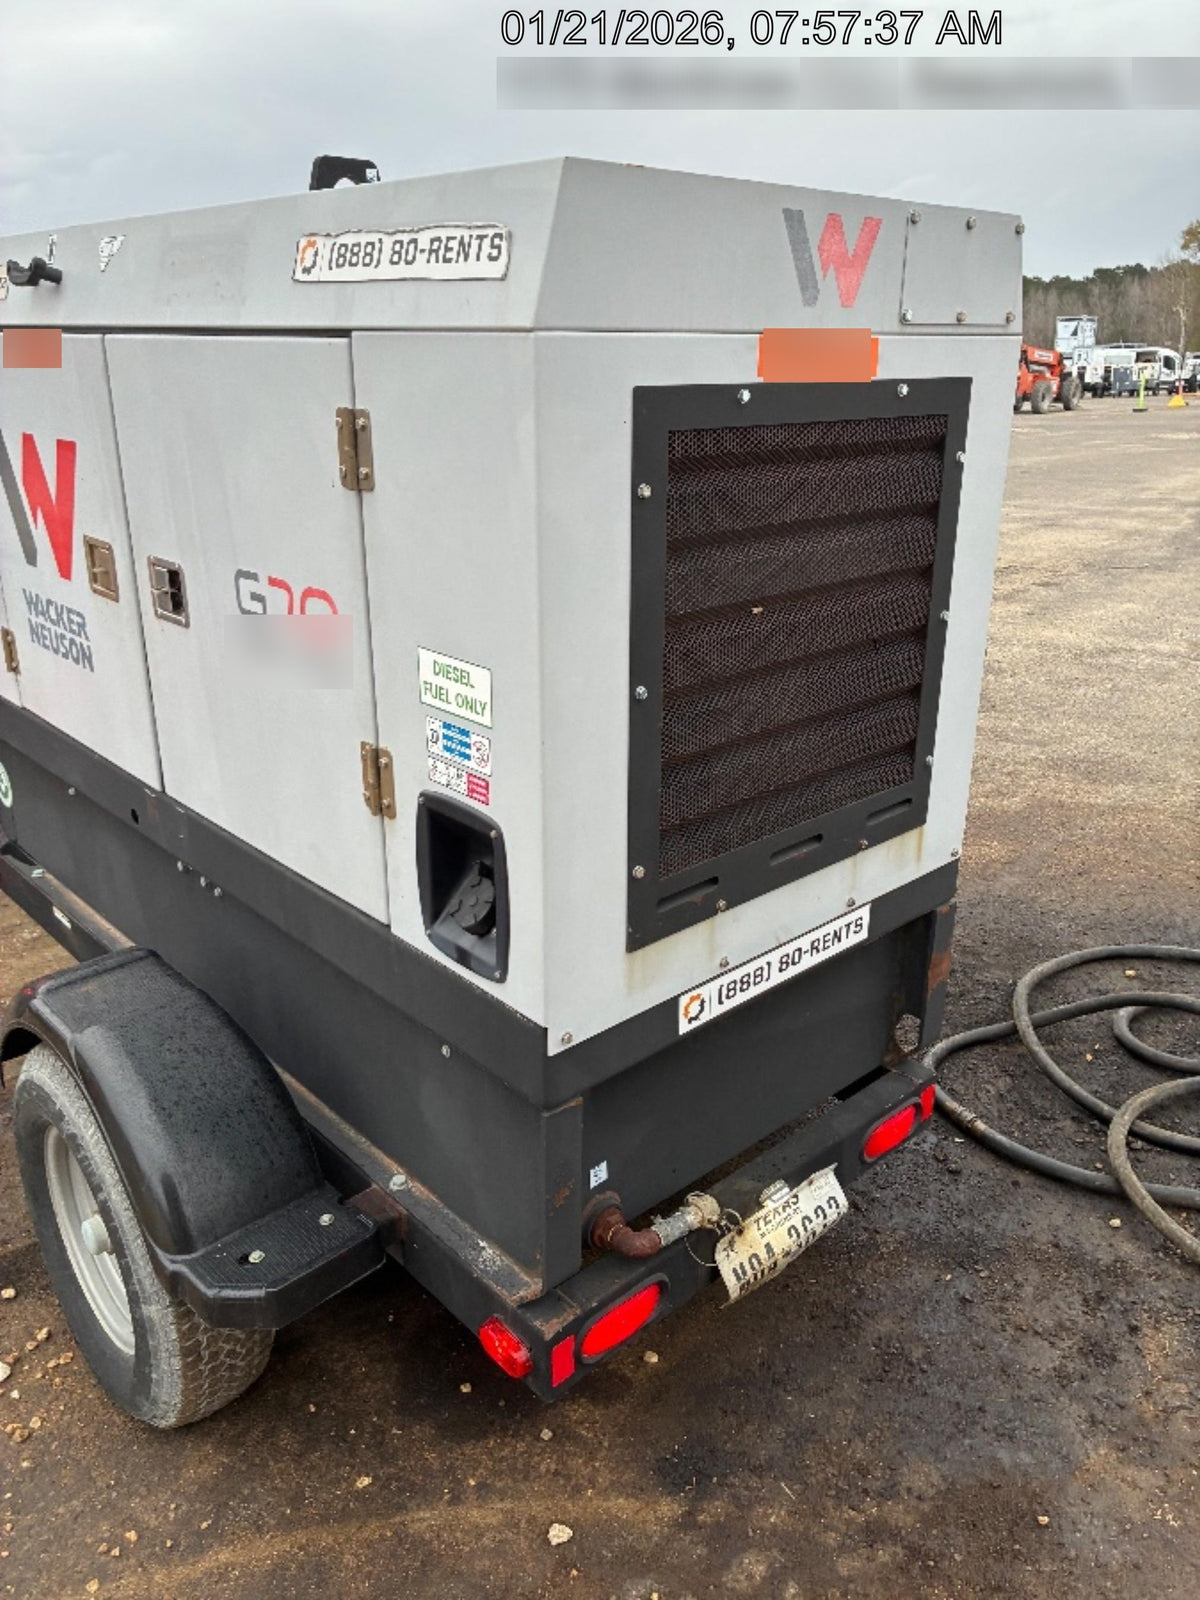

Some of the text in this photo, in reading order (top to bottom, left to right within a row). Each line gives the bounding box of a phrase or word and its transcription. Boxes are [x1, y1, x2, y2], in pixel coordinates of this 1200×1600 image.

[328, 232, 504, 271] (888) 80-RENTS
[22, 588, 91, 641] WACKER
[28, 618, 95, 672] NEUSON
[432, 658, 476, 689] DIESEL
[422, 680, 487, 717] FUEL ONLY
[717, 916, 864, 1005] (888) 80-RENTS
